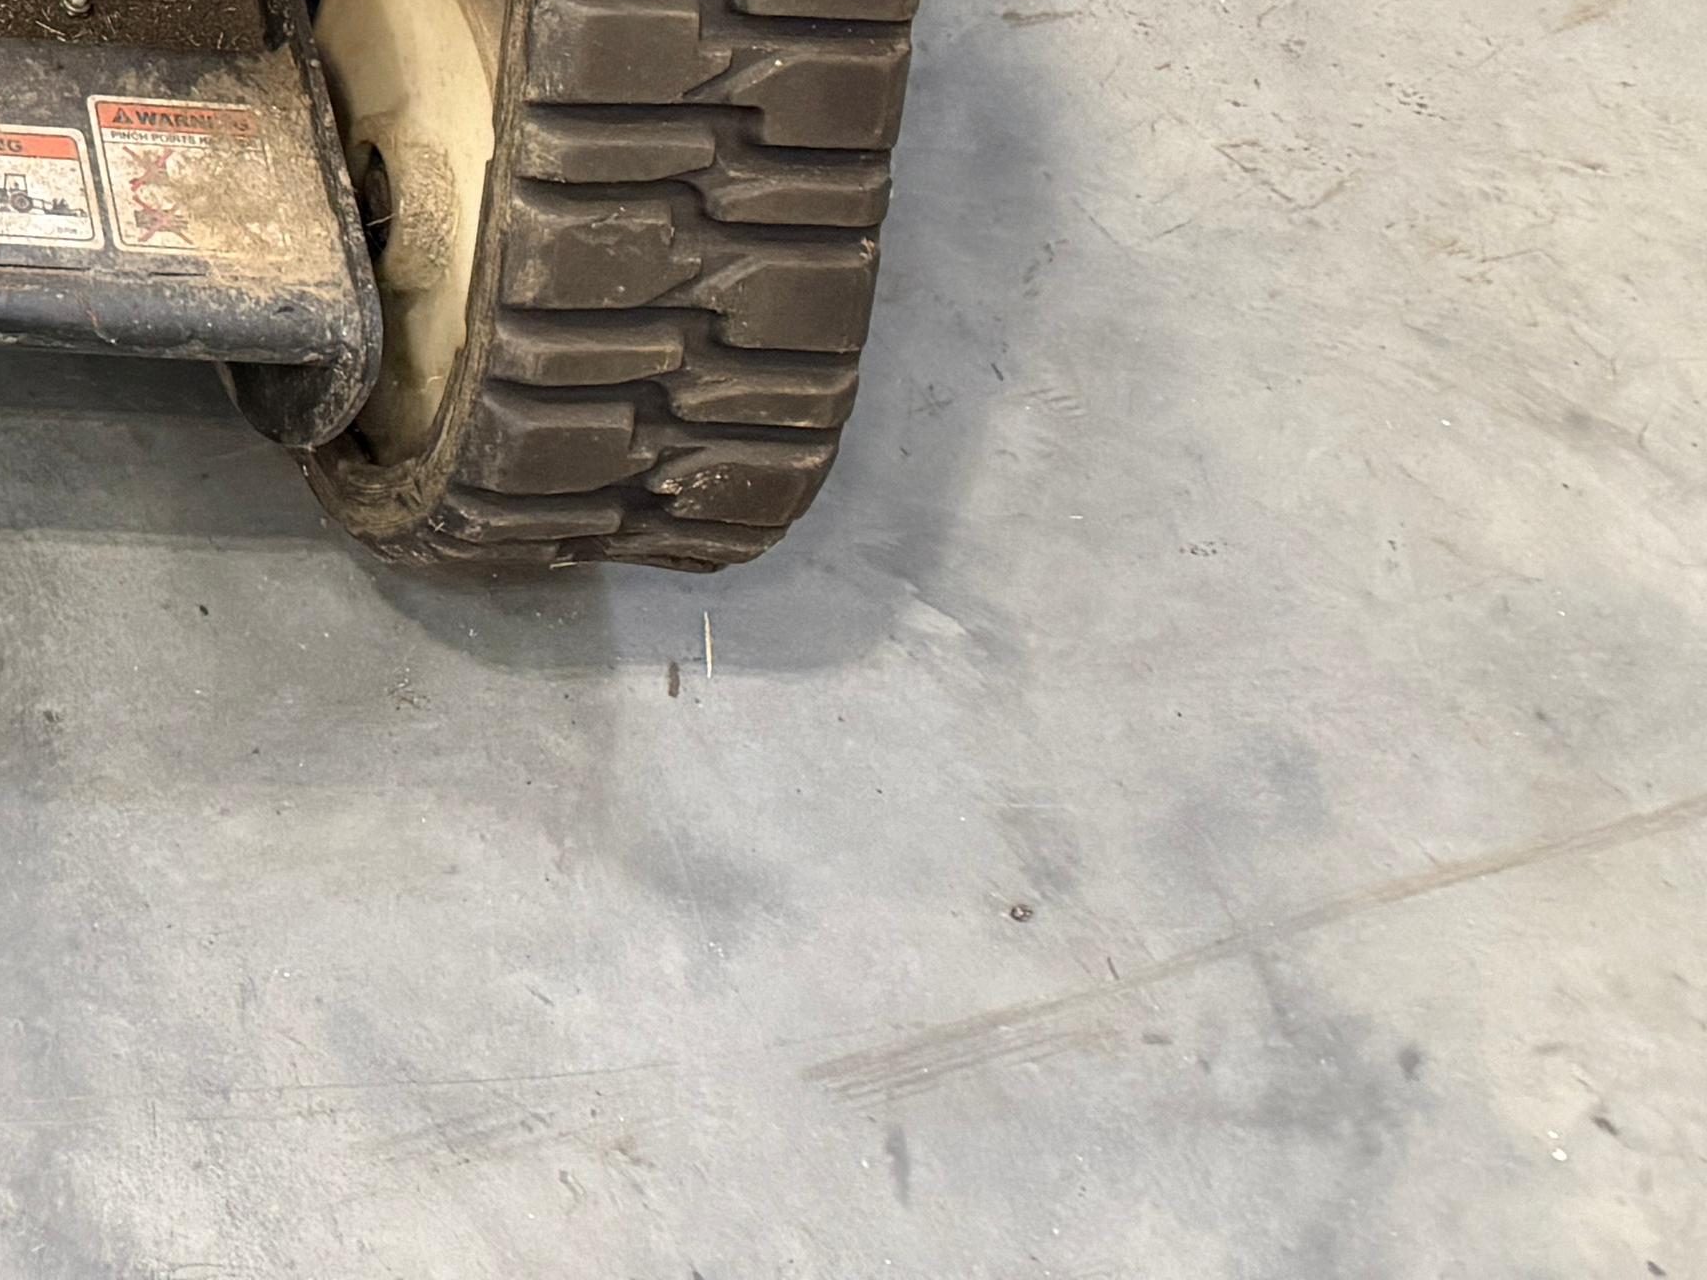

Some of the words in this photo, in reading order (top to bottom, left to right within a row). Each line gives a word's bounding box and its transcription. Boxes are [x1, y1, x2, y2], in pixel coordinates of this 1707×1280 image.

[135, 110, 250, 132] WARNIG
[110, 130, 149, 141] PINCH
[150, 132, 196, 144] POINTS
